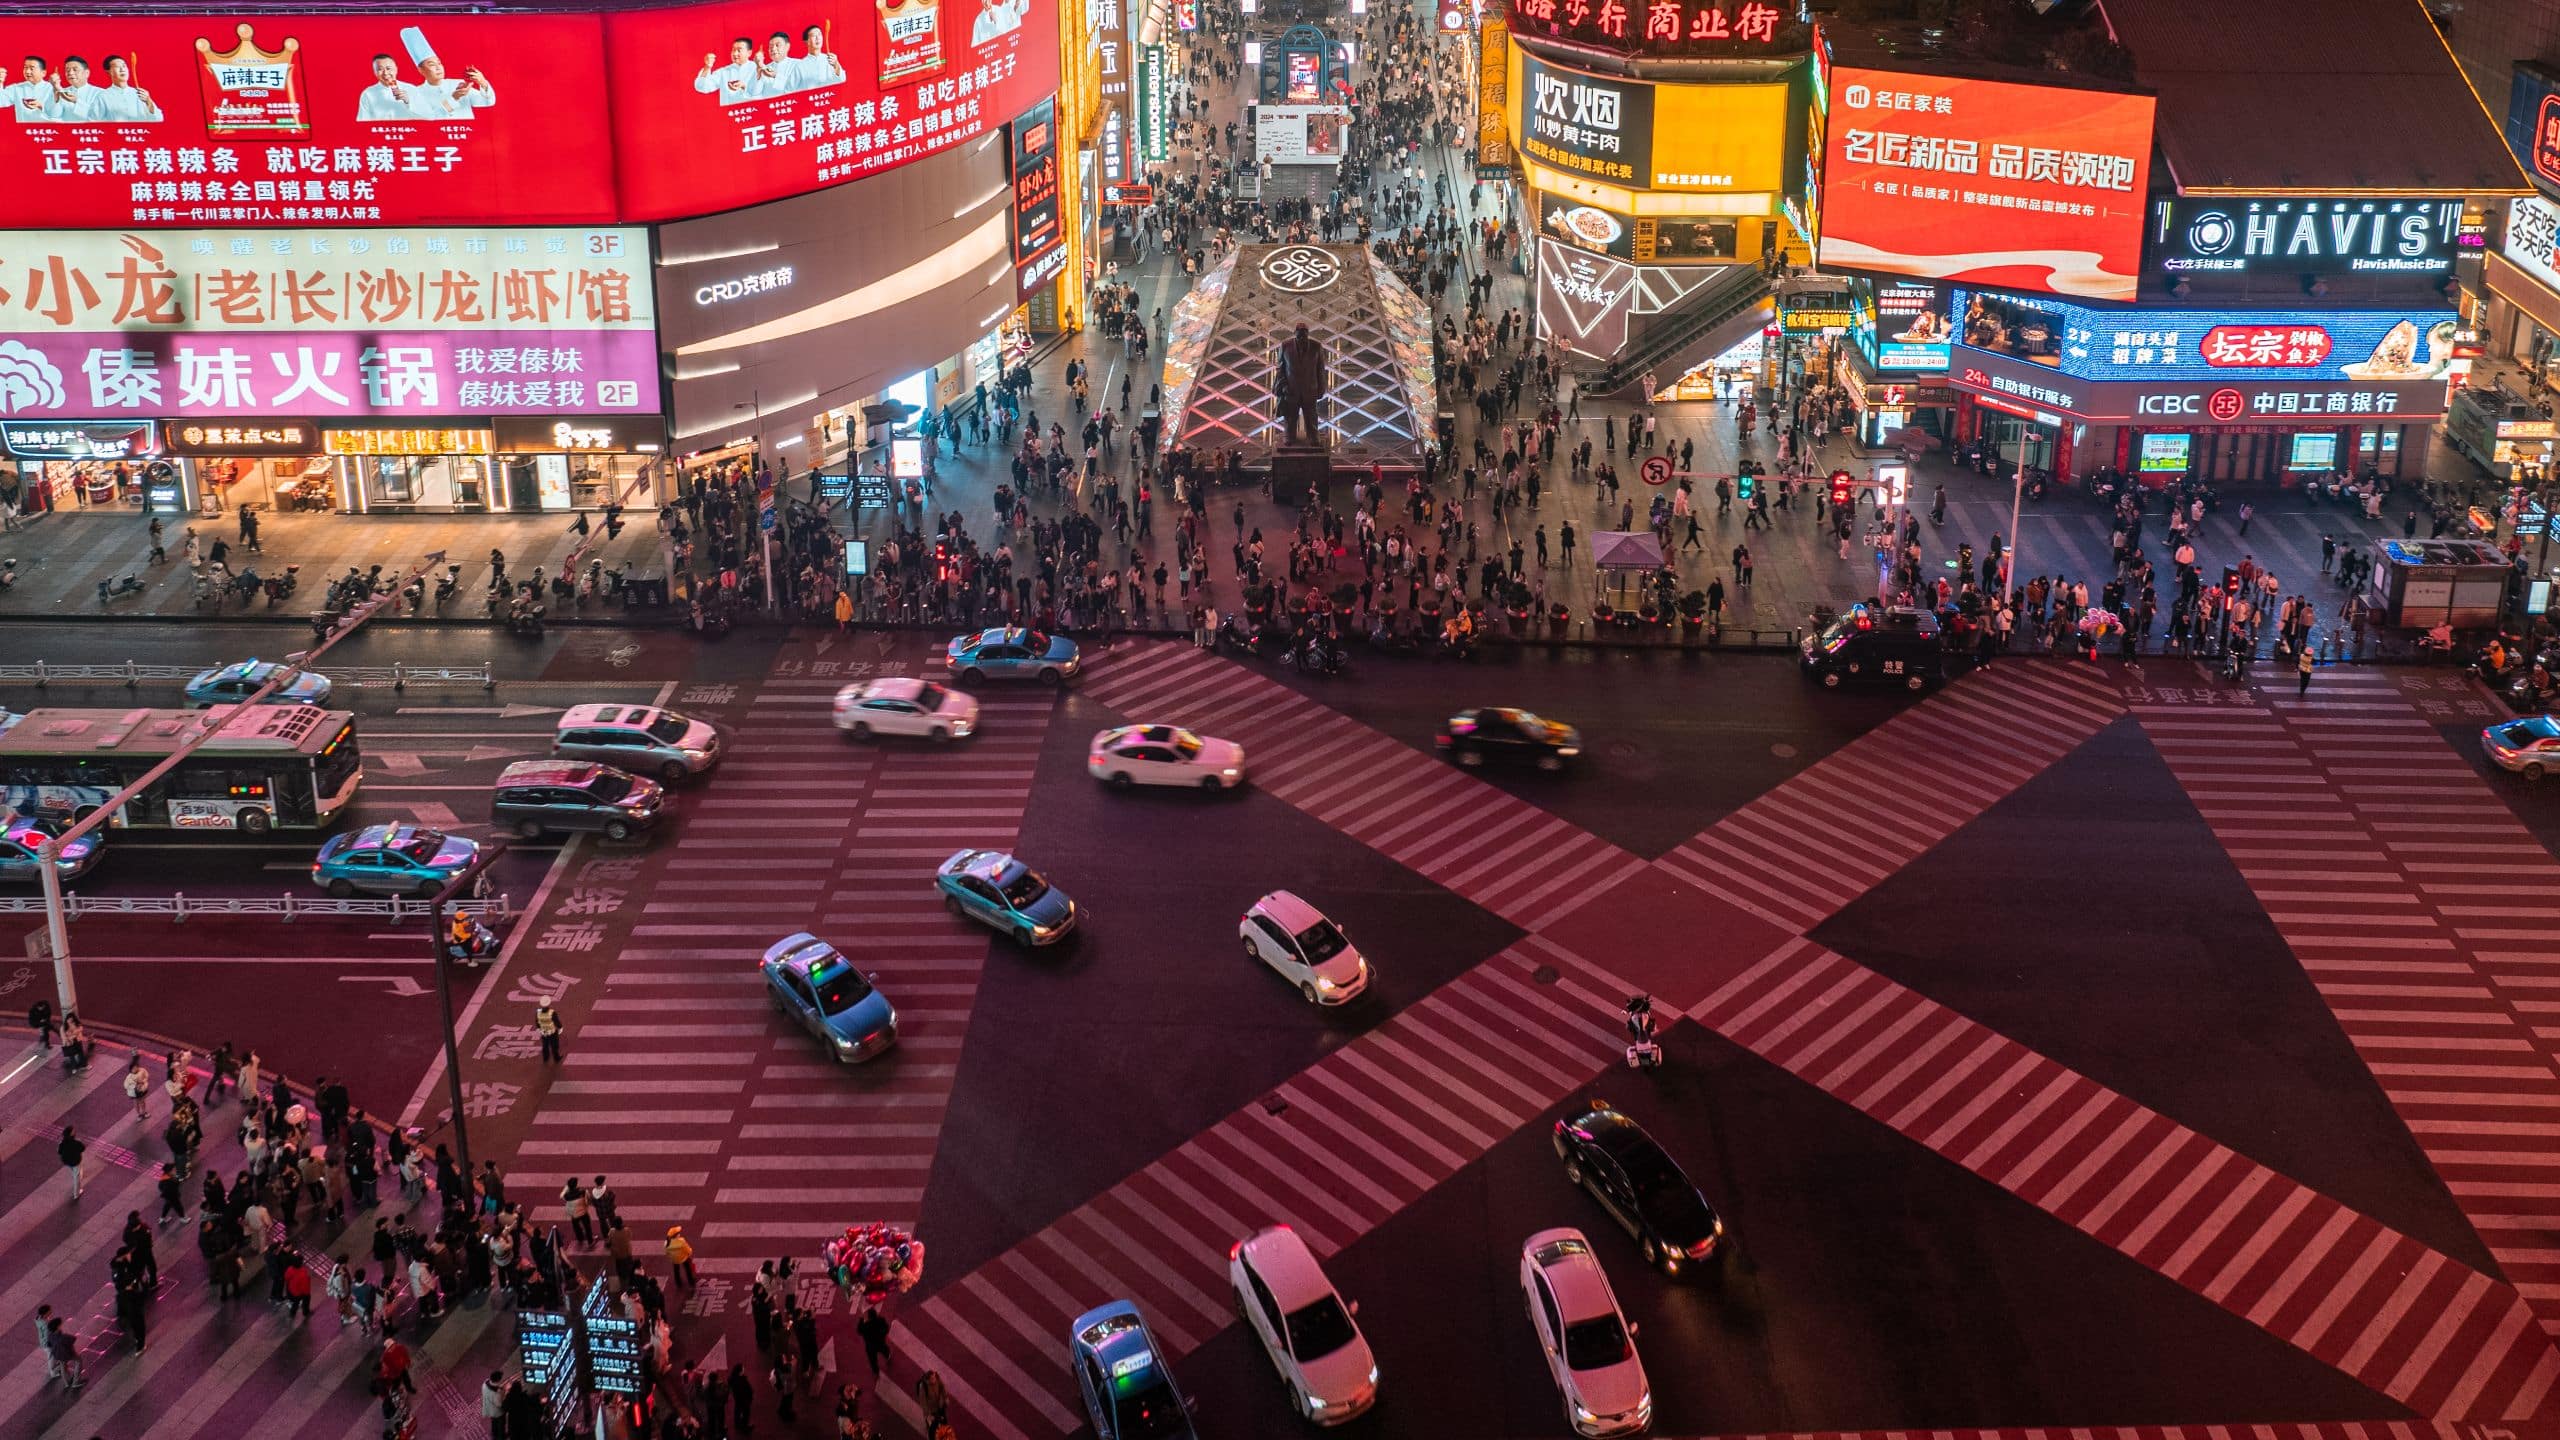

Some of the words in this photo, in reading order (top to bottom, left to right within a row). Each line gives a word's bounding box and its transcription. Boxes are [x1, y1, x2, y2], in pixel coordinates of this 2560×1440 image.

[892, 15, 933, 38] 麻辣王子
[1648, 2, 1779, 42] 商业街
[222, 69, 284, 86] 麻辣王子
[917, 53, 1016, 111] 就吃麻辣王子
[1149, 50, 1161, 157] metersbonwe
[1482, 30, 1506, 163] 周六福珠宝
[1534, 72, 1621, 131] 炊烟
[741, 96, 900, 153] 正宗麻辣辣条
[816, 100, 980, 164] 麻辣辣条全国销量领先
[1534, 115, 1620, 153] 小炒黄牛肉
[42, 147, 240, 175] 正宗麻辣辣条
[266, 146, 462, 173] 就吃麻辣王子
[1843, 128, 1979, 175] 名匠新品
[1988, 143, 2136, 192] 品质领跑
[131, 179, 375, 202] 麻辣辣条全国销量领先
[133, 207, 381, 221] 携手新一代川菜掌门人、辣条发明人研发
[191, 236, 567, 256] 唤醒老长沙的城市味觉
[588, 235, 618, 253] 3F
[2245, 214, 2430, 257] HAVIS
[0, 250, 185, 325] 小龙
[2209, 330, 2285, 364] 坛宗
[2288, 330, 2325, 347] 剁椒
[455, 347, 583, 374] 我爱傣妹
[2112, 349, 2178, 364] 招牌菜
[2286, 349, 2323, 364] 鱼头
[82, 346, 439, 408] 傣妹火锅
[1964, 368, 1990, 386] 24h
[1992, 376, 2073, 408] 自助银行服务
[458, 380, 584, 408] 傣妹爱我
[603, 385, 633, 403] 2F
[2138, 395, 2200, 414] ICBC
[2253, 391, 2399, 413] 中国工商银行
[9, 430, 77, 446] 湖南特产
[1884, 660, 1904, 669] 特警
[181, 805, 218, 815] 百岁山
